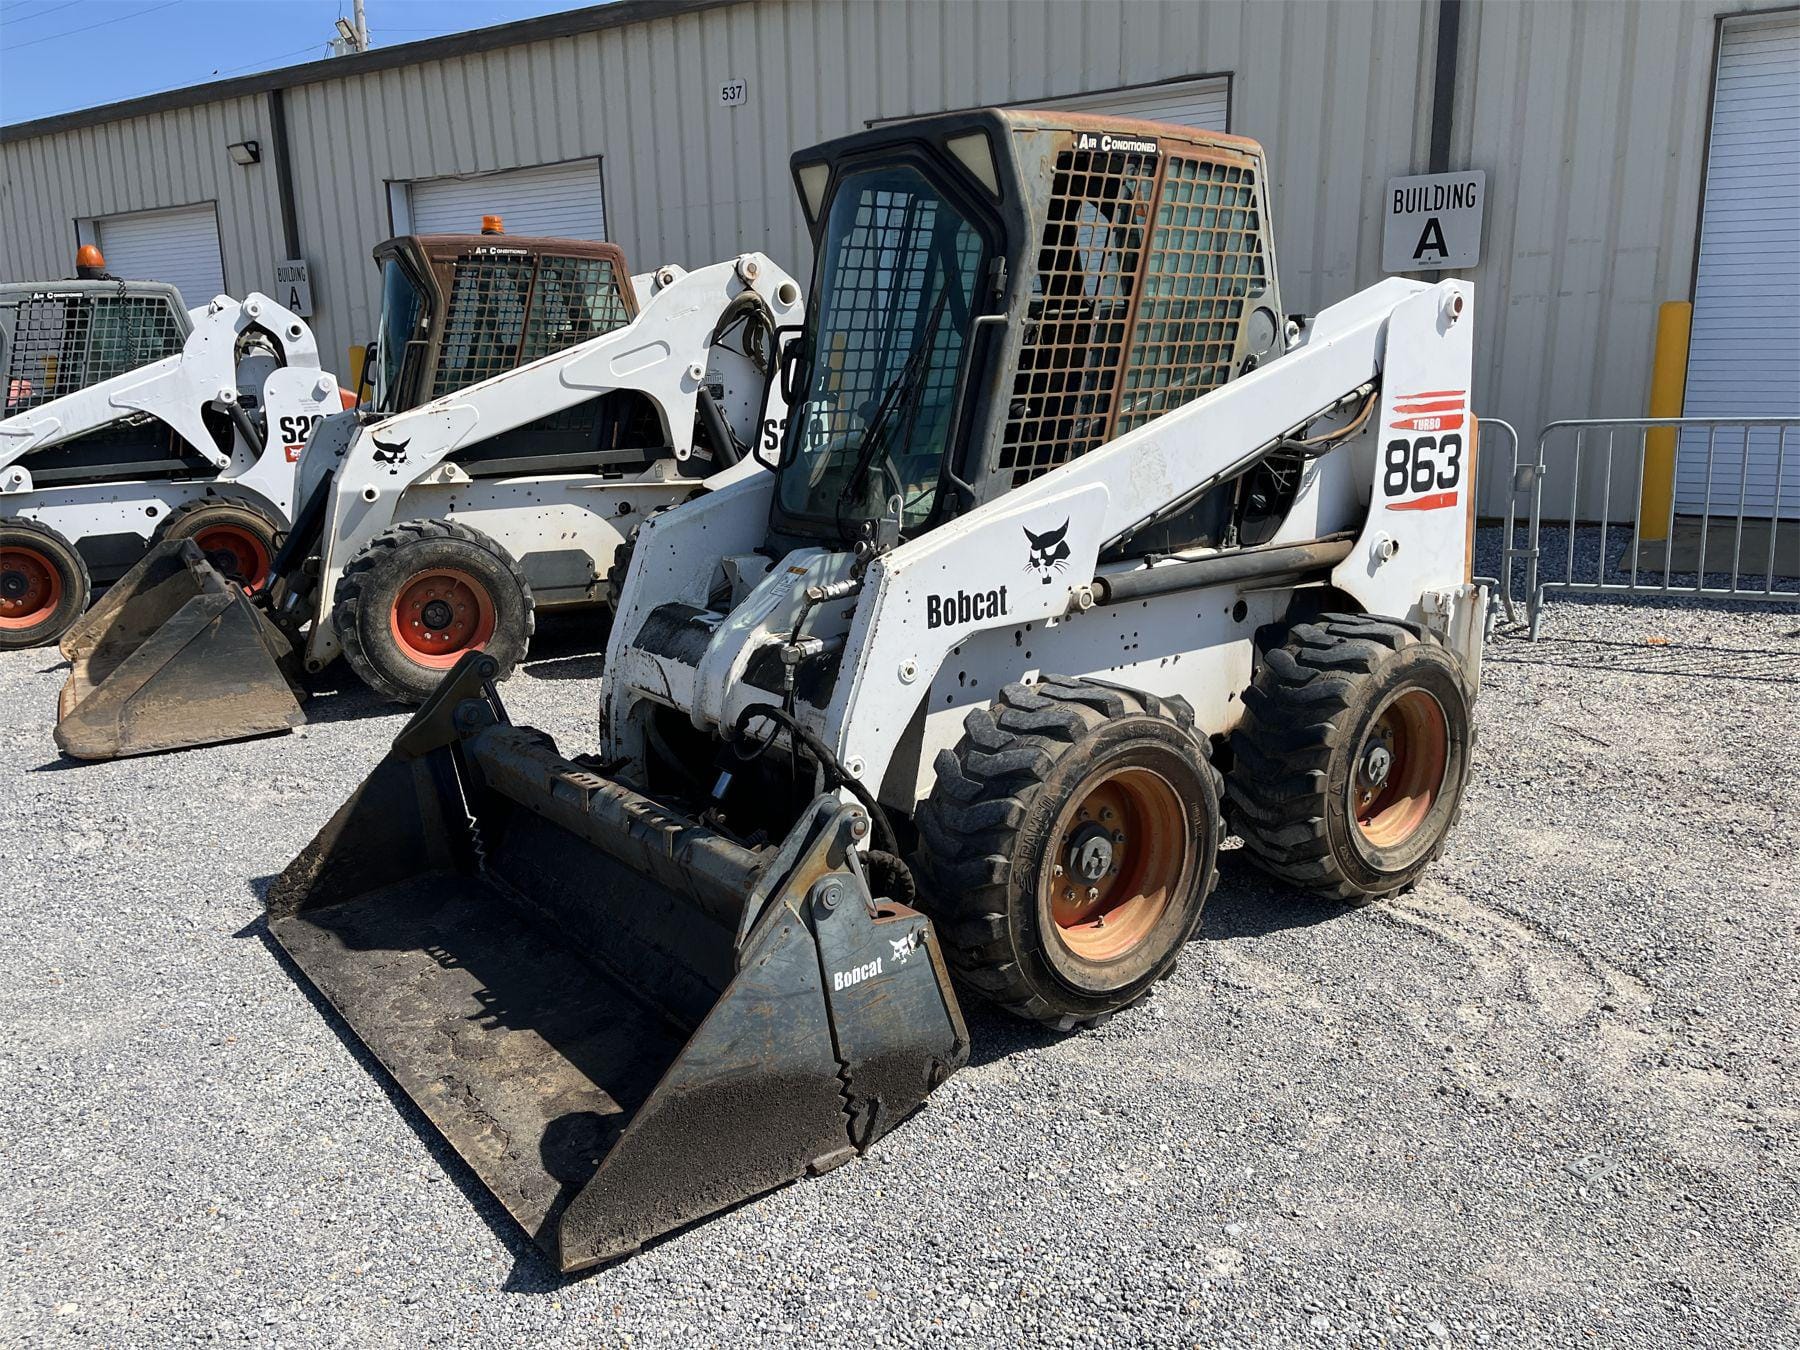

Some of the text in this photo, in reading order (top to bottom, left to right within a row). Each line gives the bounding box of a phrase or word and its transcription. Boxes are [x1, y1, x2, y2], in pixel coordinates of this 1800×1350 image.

[722, 85, 742, 101] 537
[1078, 133, 1156, 153] AIR CONDITIONED
[1393, 182, 1477, 214] BUILDING
[1412, 217, 1449, 259] A
[277, 265, 306, 282] BUILDING
[290, 286, 302, 311] A
[280, 414, 336, 444] S2
[1412, 417, 1441, 430] TURBO
[1384, 433, 1462, 497] 863
[927, 585, 1008, 629] Bobcat
[833, 956, 883, 992] Bobcat
